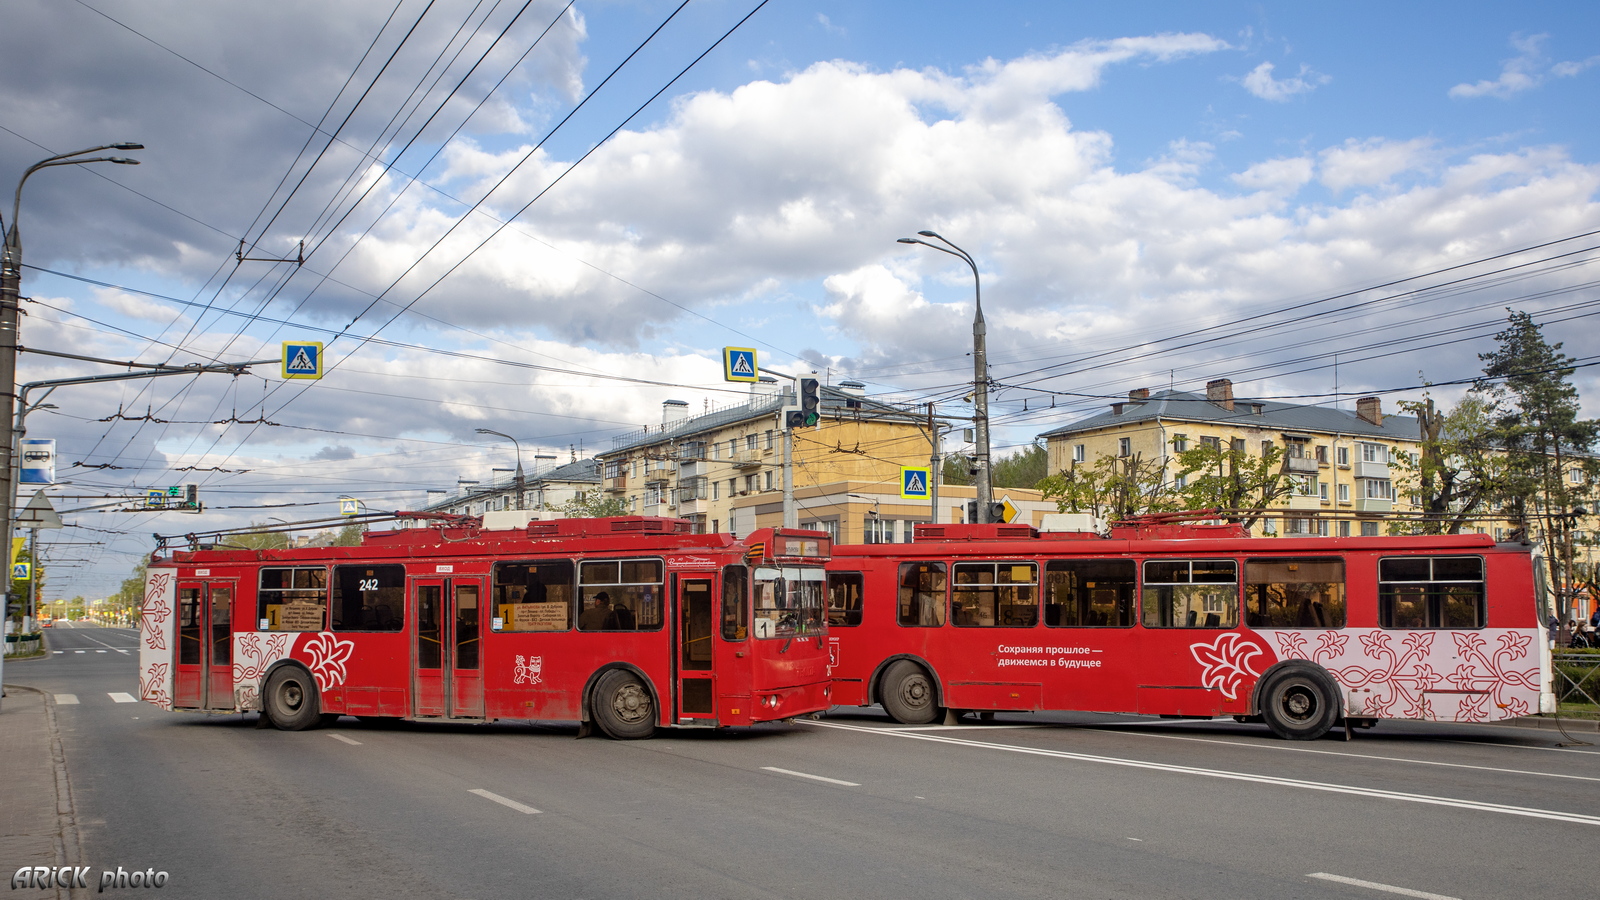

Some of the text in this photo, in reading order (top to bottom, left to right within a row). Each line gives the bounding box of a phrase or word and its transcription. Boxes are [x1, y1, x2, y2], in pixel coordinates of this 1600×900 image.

[359, 579, 379, 591] 242
[270, 609, 277, 626] 1
[503, 608, 510, 625] 1
[760, 621, 768, 638] 1
[997, 644, 1043, 655] Сохраняя
[1045, 645, 1090, 656] прошлое
[997, 657, 1102, 669] движемся в будущее
